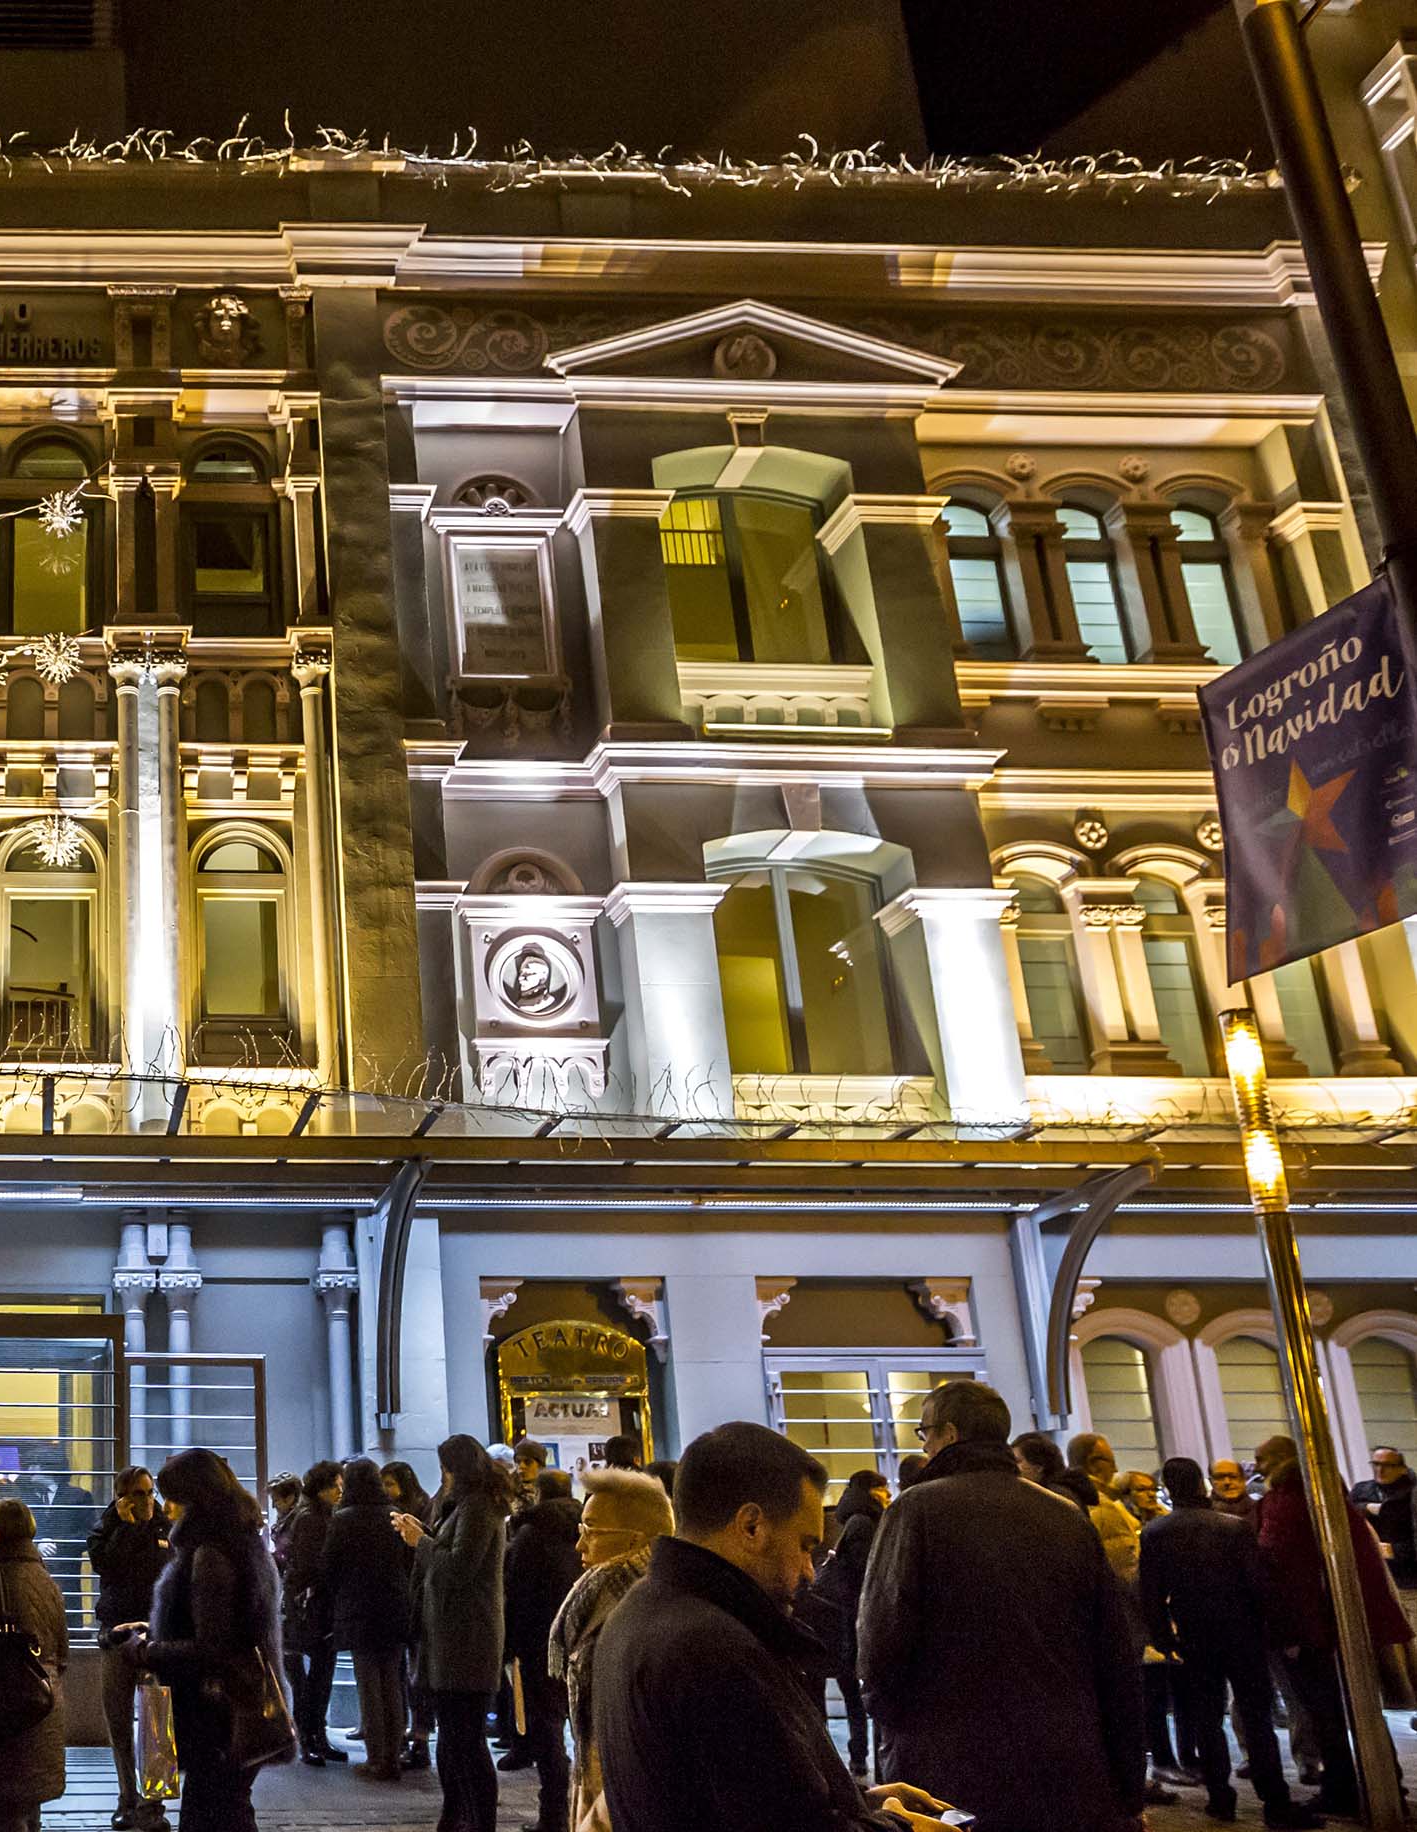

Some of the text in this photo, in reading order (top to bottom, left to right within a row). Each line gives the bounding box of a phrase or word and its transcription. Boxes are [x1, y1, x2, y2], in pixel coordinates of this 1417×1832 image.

[1227, 635, 1364, 730] Logroño
[1244, 656, 1405, 765] Navidad
[512, 1327, 630, 1360] TEATRO
